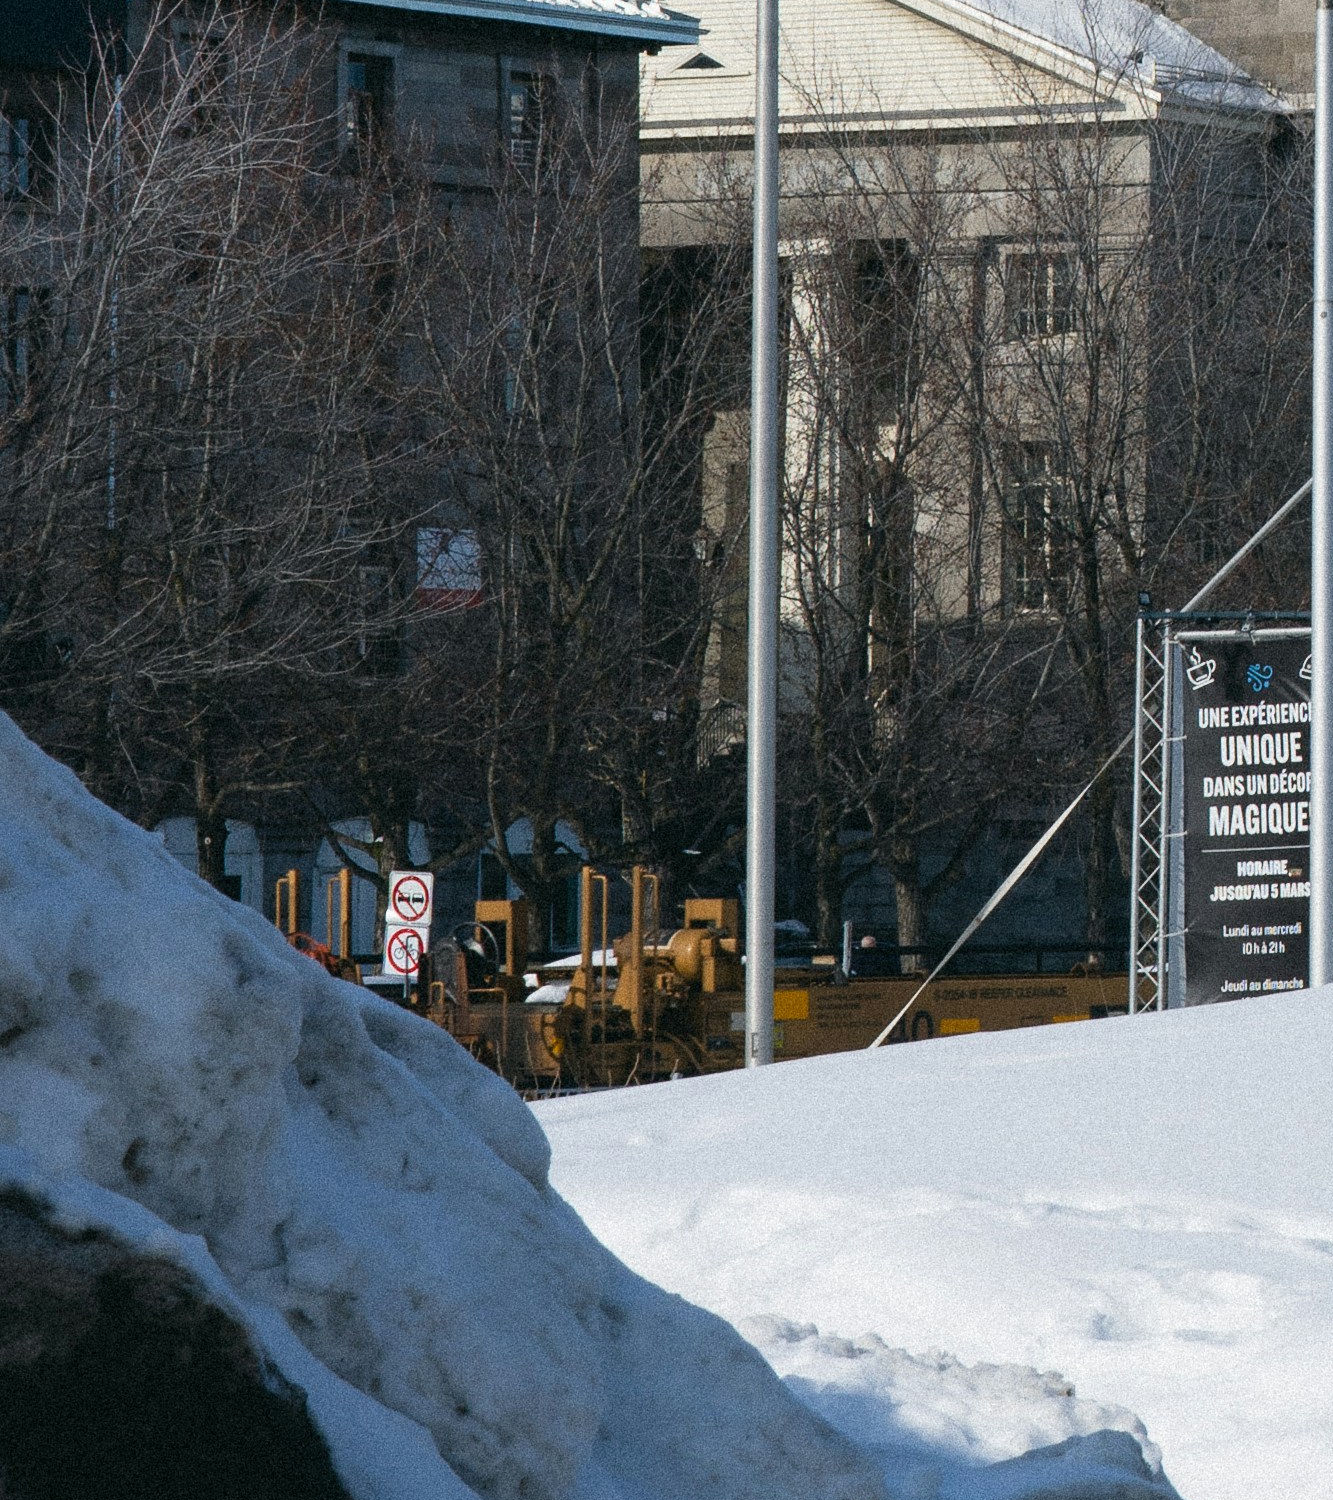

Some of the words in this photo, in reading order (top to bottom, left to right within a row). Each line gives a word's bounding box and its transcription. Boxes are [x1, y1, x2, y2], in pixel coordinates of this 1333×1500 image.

[1198, 706, 1230, 729] UNE
[1220, 731, 1303, 767] UNIQUE
[1203, 775, 1245, 798] DANS
[1246, 773, 1268, 796] UN
[1237, 859, 1289, 877] HORAIRE
[1209, 883, 1269, 902] JUSQU'AU
[1270, 883, 1279, 899] 5
[1280, 881, 1311, 899] MARS
[1223, 924, 1250, 938] Lundi
[1250, 926, 1263, 937] au
[1264, 921, 1302, 936] mercredi
[1220, 979, 1248, 993] Jeudi
[1249, 981, 1261, 992] au
[1262, 977, 1304, 991] dimanche
